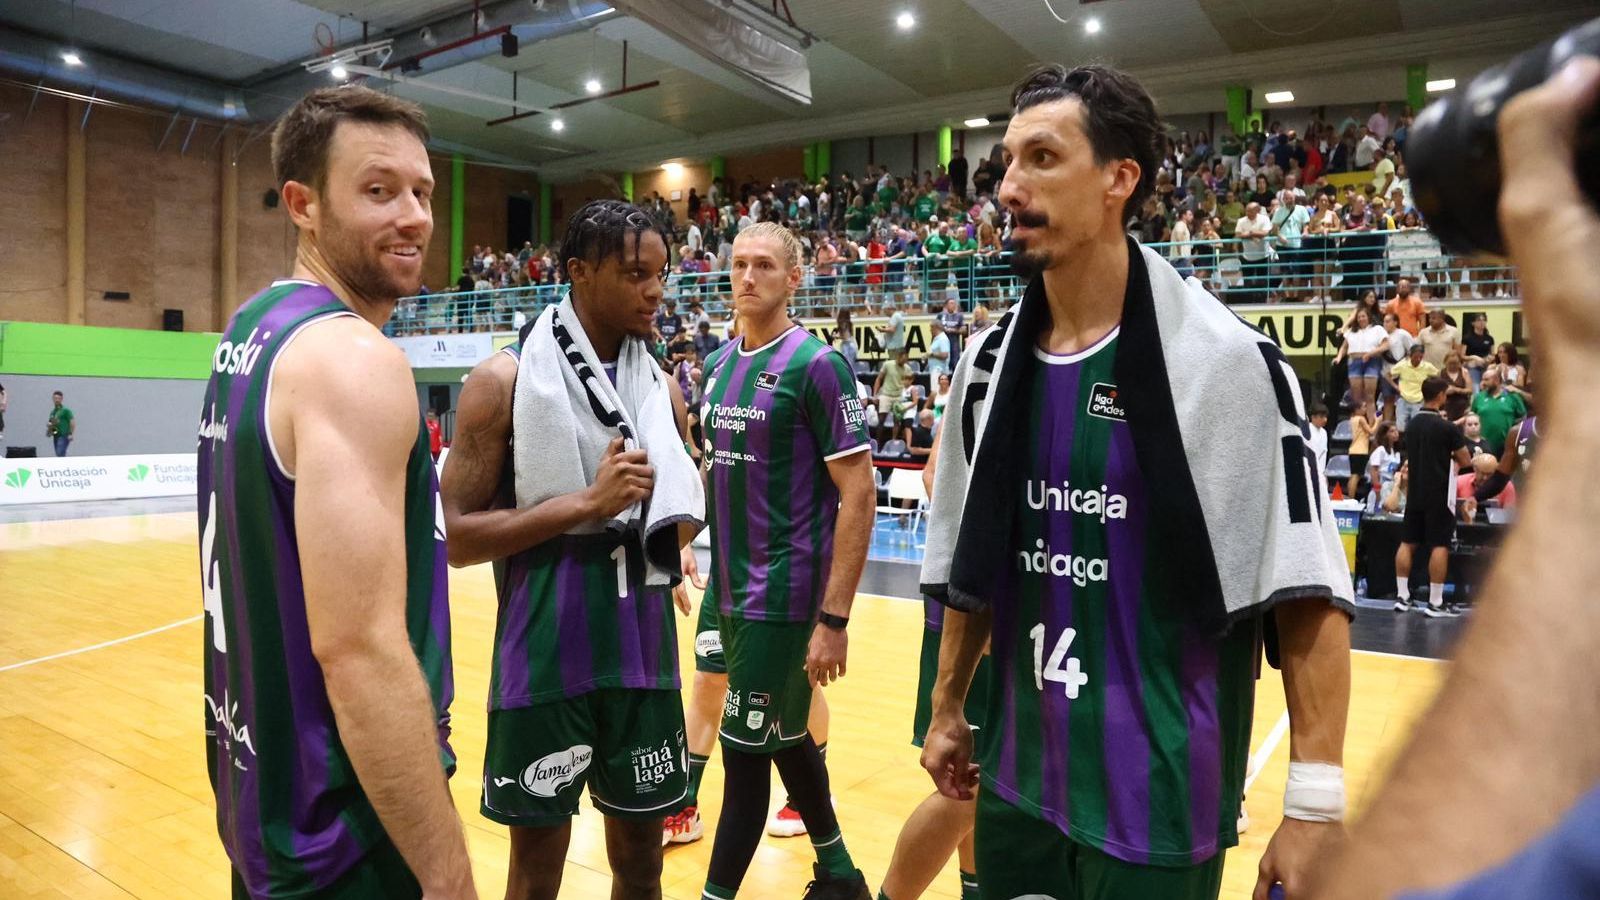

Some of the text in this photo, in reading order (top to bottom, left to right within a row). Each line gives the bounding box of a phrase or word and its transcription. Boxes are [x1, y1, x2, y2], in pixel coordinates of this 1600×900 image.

[213, 327, 271, 376] oski
[1095, 393, 1114, 405] liga
[712, 403, 766, 421] Fundación
[1092, 403, 1125, 417] endes
[711, 416, 746, 434] Unicaja
[731, 452, 743, 460] DEL
[743, 454, 757, 462] SOL
[37, 467, 108, 478] Fundación
[153, 463, 197, 474] Fundac
[40, 477, 92, 489] Unicaja
[156, 473, 197, 484] Unicaj
[1027, 479, 1129, 524] Unicaja
[1338, 517, 1353, 528] RE
[1029, 622, 1089, 700] 14
[631, 746, 652, 756] sabor
[632, 739, 674, 769] a má
[633, 761, 676, 784] laga
